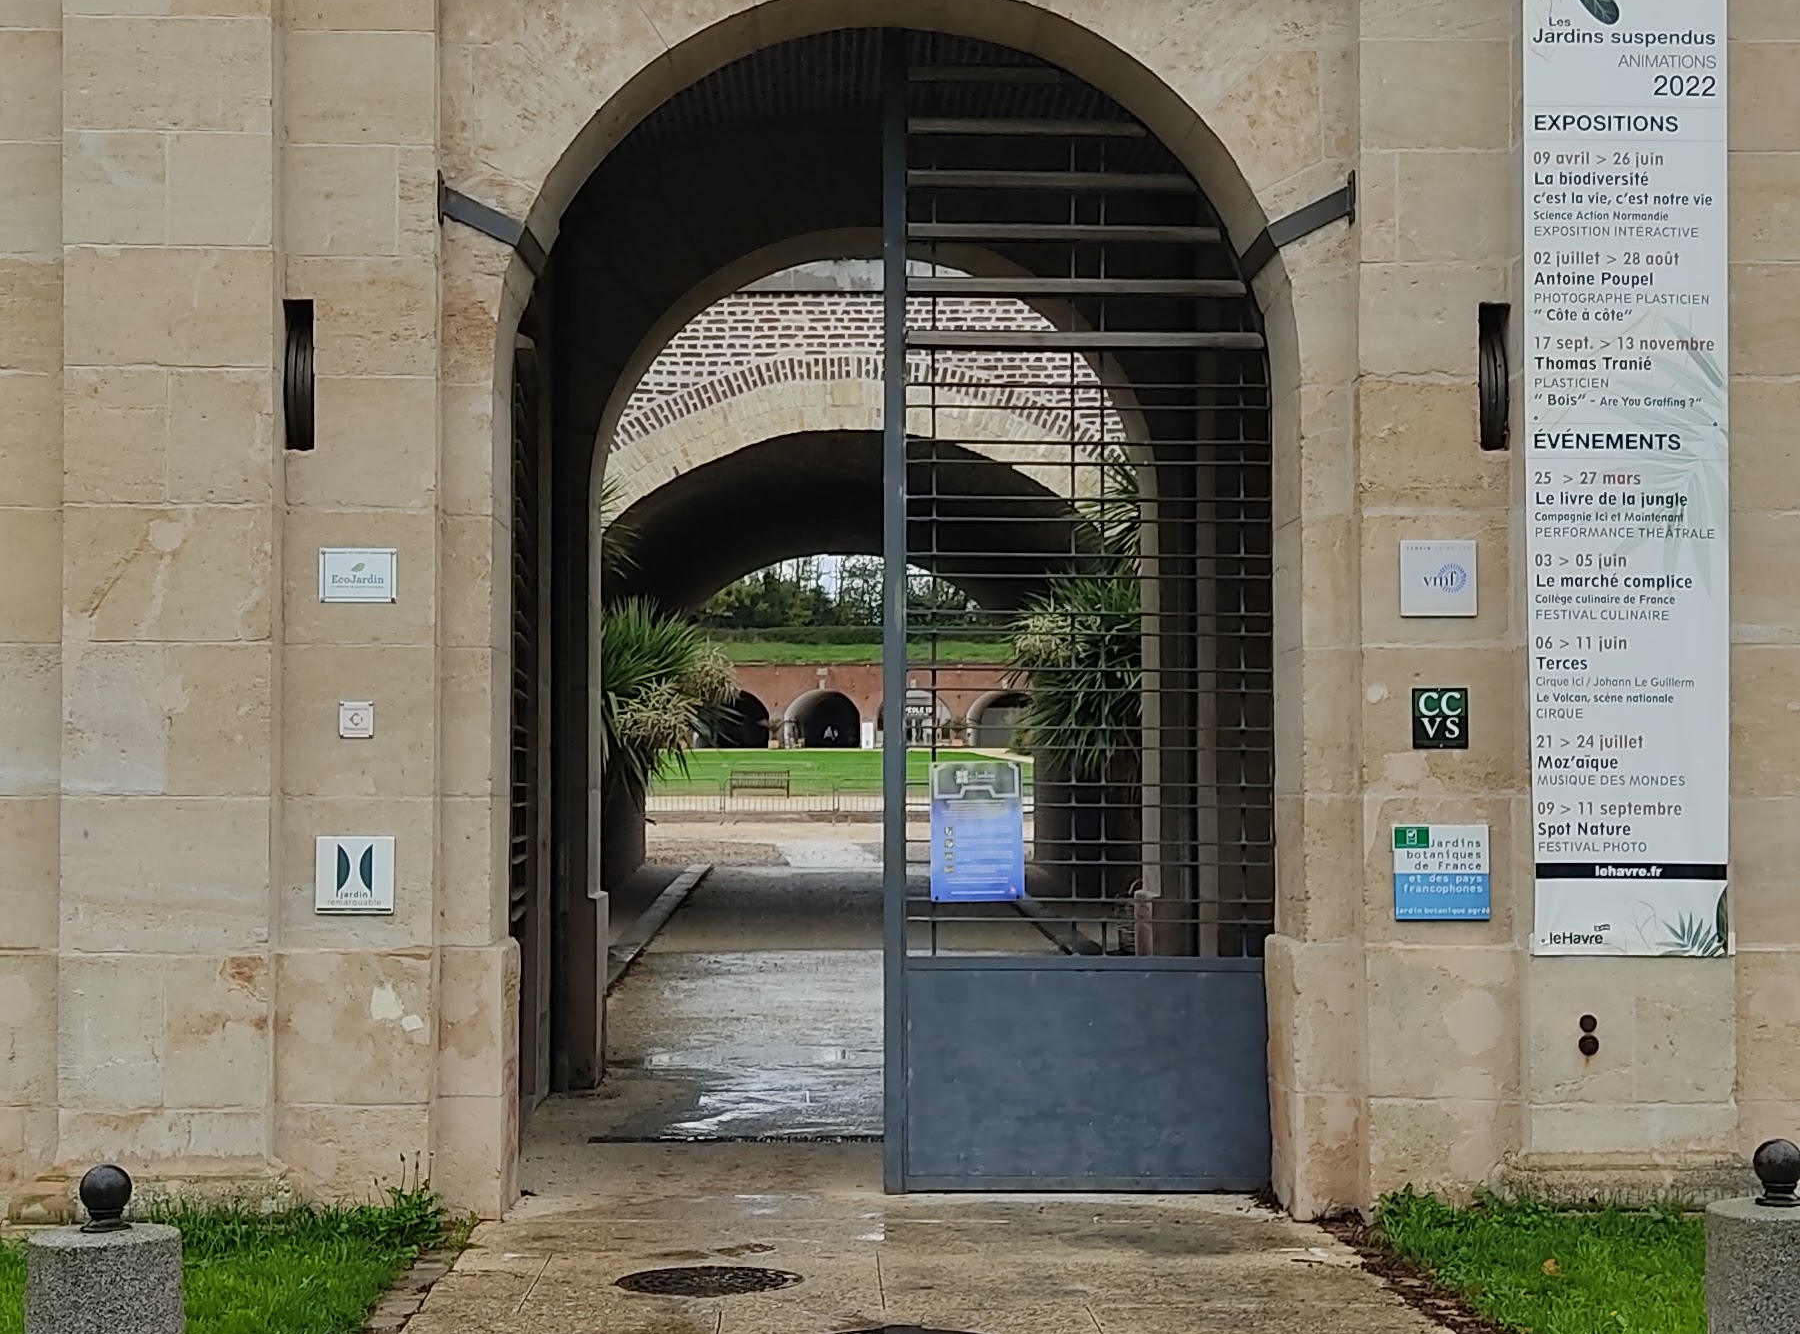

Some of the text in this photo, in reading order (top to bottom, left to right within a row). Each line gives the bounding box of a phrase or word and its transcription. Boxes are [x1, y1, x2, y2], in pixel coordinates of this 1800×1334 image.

[1549, 17, 1571, 26] Les
[1533, 29, 1716, 47] Jardins suspendus
[1618, 55, 1716, 68] ANIMATIONS
[1654, 76, 1716, 96] 2022
[1534, 115, 1678, 132] EXPOSITIONS
[1534, 152, 1551, 165] 09
[1556, 152, 1590, 165] avril
[1613, 152, 1630, 165] 26
[1635, 152, 1663, 168] juin
[1534, 172, 1649, 186] La biodiversité
[1572, 193, 1583, 204] la
[1588, 194, 1611, 206] vie,
[1654, 195, 1689, 205] notre
[1694, 195, 1712, 206] vie
[1534, 211, 1669, 221] Science Action Normandie
[1534, 227, 1610, 236] EXPOSITION
[1534, 252, 1550, 265] 02
[1556, 252, 1600, 268] juillet
[1623, 253, 1640, 265] 28
[1646, 251, 1679, 265] août
[1534, 272, 1653, 288] Antoine Poupel
[1534, 293, 1709, 305] PHOTOGRAPHE PLASTICIEN
[1547, 308, 1577, 321] Côte
[1582, 309, 1590, 321] à
[1534, 337, 1550, 349] 17
[1557, 337, 1594, 352] sept.
[1618, 337, 1634, 350] 13
[1640, 337, 1714, 351] novembre
[1534, 356, 1651, 370] Thomas Tranié
[1535, 378, 1609, 388] PLASTICIEN
[1600, 397, 1618, 407] Are
[1622, 398, 1641, 407] You
[1534, 429, 1681, 451] ÉVÉNEMENTS
[1534, 472, 1551, 484] 25
[1580, 473, 1597, 484] 27
[1603, 474, 1641, 485] mars
[1536, 492, 1687, 509] Le livre de la jungle
[1535, 512, 1591, 523] Compagnie
[1611, 513, 1621, 522] et
[1624, 513, 1683, 522] Maintenant
[1535, 525, 1715, 539] PERFORMANCE THÉÂTRALE
[1535, 554, 1552, 567] 03
[1576, 555, 1593, 567] 05
[1598, 554, 1627, 570] juin
[332, 574, 384, 583] EcoJardin
[1536, 573, 1692, 591] Le marché complice
[1535, 594, 1675, 605] Collège culinaire de France
[1536, 610, 1669, 620] FESTIVAL CULINAIRE
[1536, 637, 1552, 649] 06
[1577, 637, 1591, 649] 11
[1599, 637, 1627, 652] juin
[1536, 657, 1588, 670] Terces
[1536, 677, 1569, 688] Cirque
[1594, 677, 1631, 687] Johann
[1635, 678, 1647, 687] Le
[1651, 678, 1694, 688] Guillerm
[1419, 692, 1462, 716] CC
[1537, 693, 1674, 704] Le Volcan, scène nationale
[1537, 709, 1583, 719] CIRQUE
[1420, 717, 1459, 738] VS
[1537, 735, 1552, 748] 21
[1577, 736, 1594, 748] 24
[1599, 735, 1643, 751] juillet
[1537, 775, 1685, 786] MUSIQUE DES MONDES
[1538, 803, 1554, 815] 09
[1578, 803, 1593, 815] 11
[1600, 803, 1682, 818] septembre
[1538, 823, 1631, 838] Spot Nature
[1431, 838, 1481, 847] Jardins
[1538, 842, 1647, 852] FESTIVAL PHOTO
[1407, 850, 1481, 860] botaniques
[1415, 862, 1481, 870] de France
[1429, 874, 1449, 882] des
[1456, 875, 1482, 884] pays
[341, 891, 368, 899] jardin
[1404, 884, 1483, 895] francophones
[1550, 932, 1603, 944] leHavre
